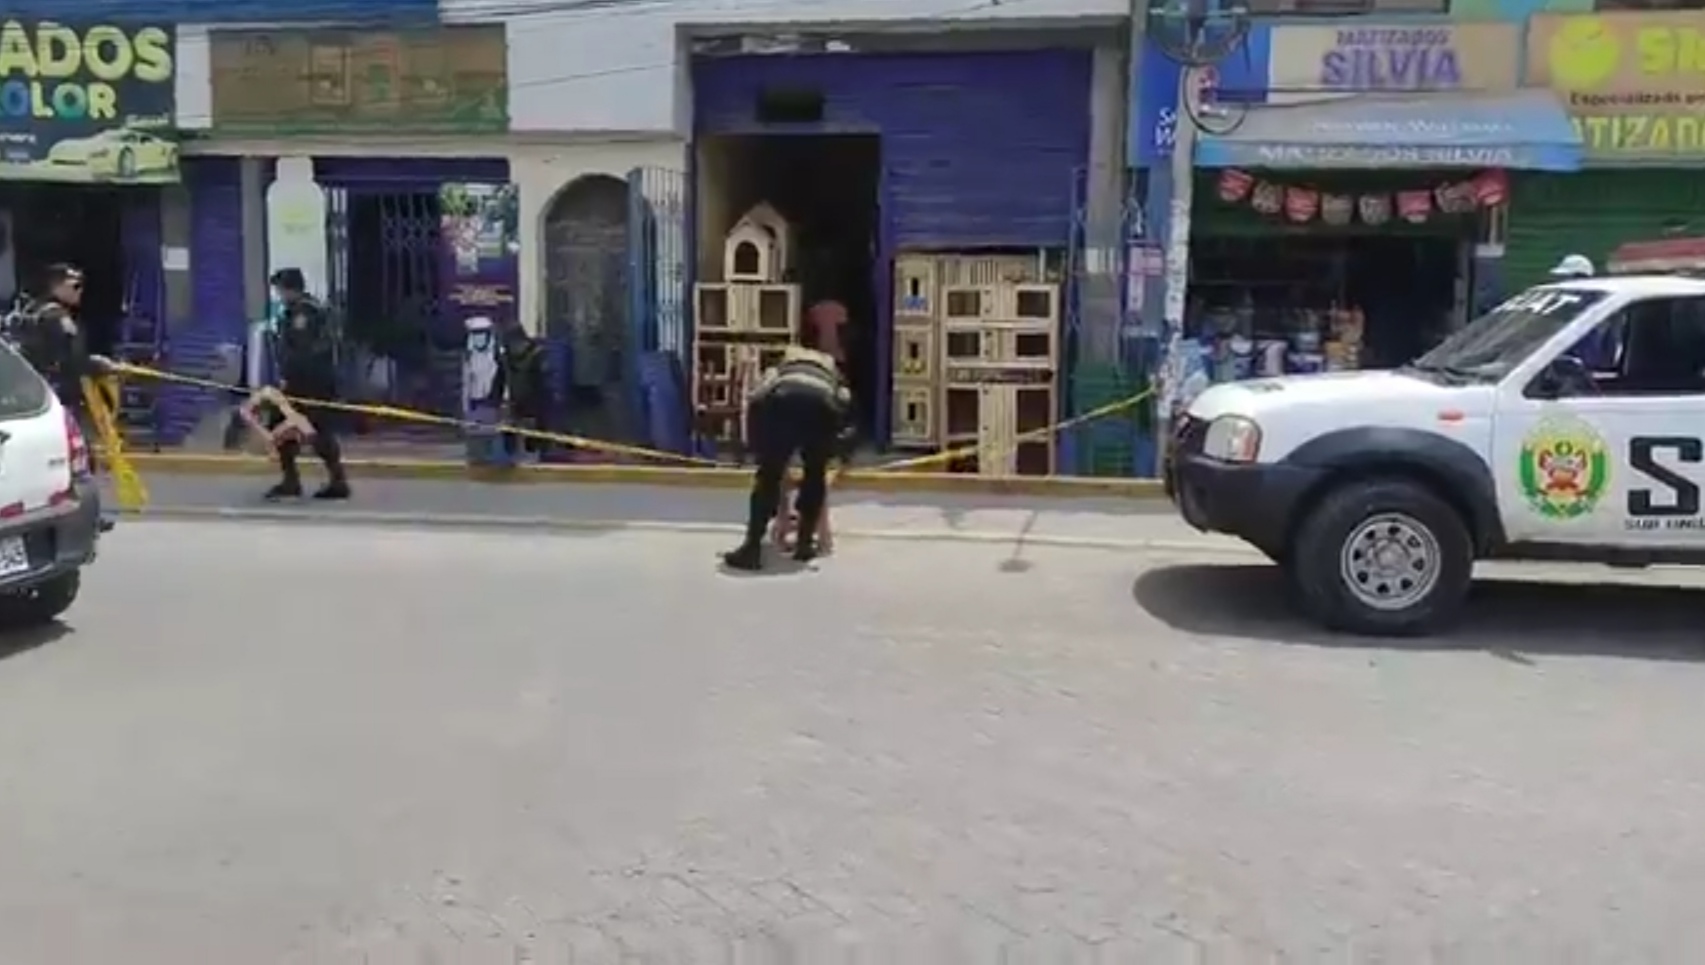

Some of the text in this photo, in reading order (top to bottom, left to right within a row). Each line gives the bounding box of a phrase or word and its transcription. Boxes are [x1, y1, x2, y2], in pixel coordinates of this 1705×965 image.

[0, 20, 172, 81] ADOS
[1322, 49, 1462, 87] SILVIA
[0, 79, 116, 119] OLOR
